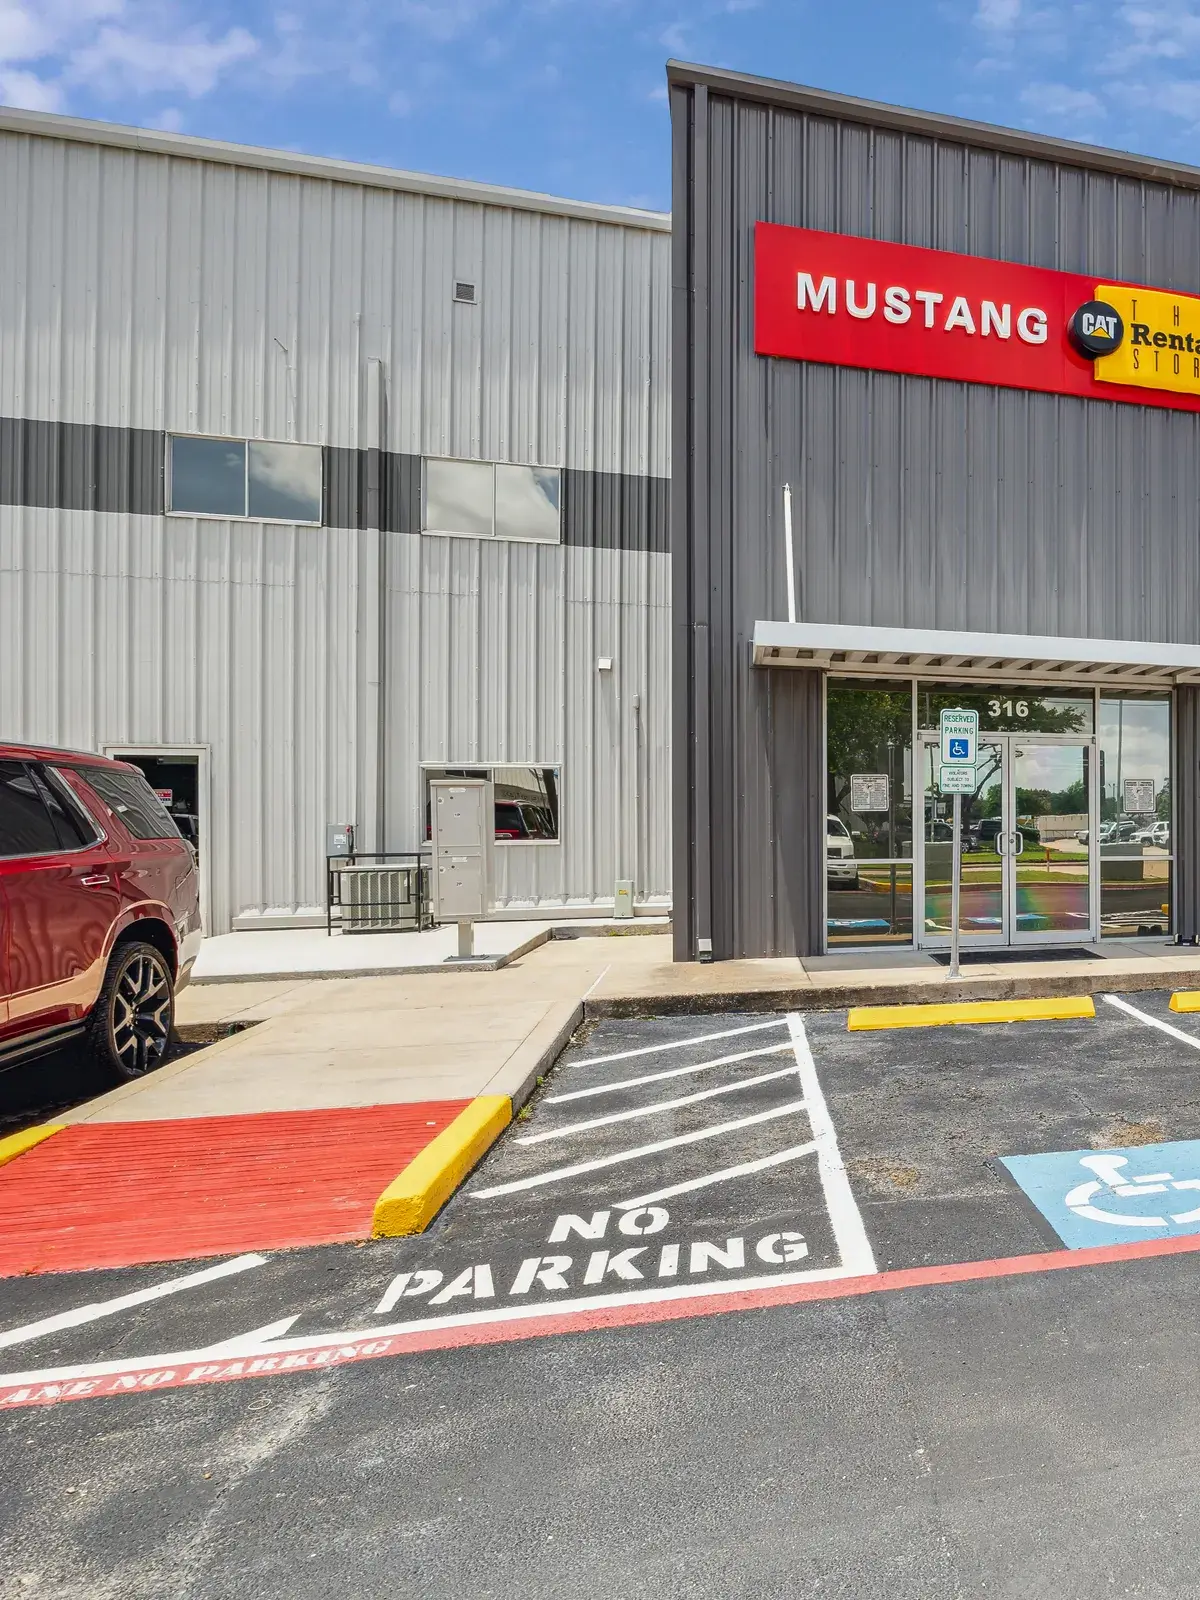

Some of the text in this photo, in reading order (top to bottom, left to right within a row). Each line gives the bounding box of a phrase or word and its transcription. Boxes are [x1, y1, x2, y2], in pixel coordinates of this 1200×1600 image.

[797, 272, 1048, 344] MUSTANG
[1082, 312, 1118, 340] CAT
[944, 714, 975, 723] RESERVED
[988, 700, 1029, 717] 316
[944, 726, 974, 735] PARKING
[548, 1206, 670, 1243] NO
[373, 1231, 810, 1315] PARKING
[106, 1370, 176, 1391] NO
[181, 1340, 393, 1382] PARKING
